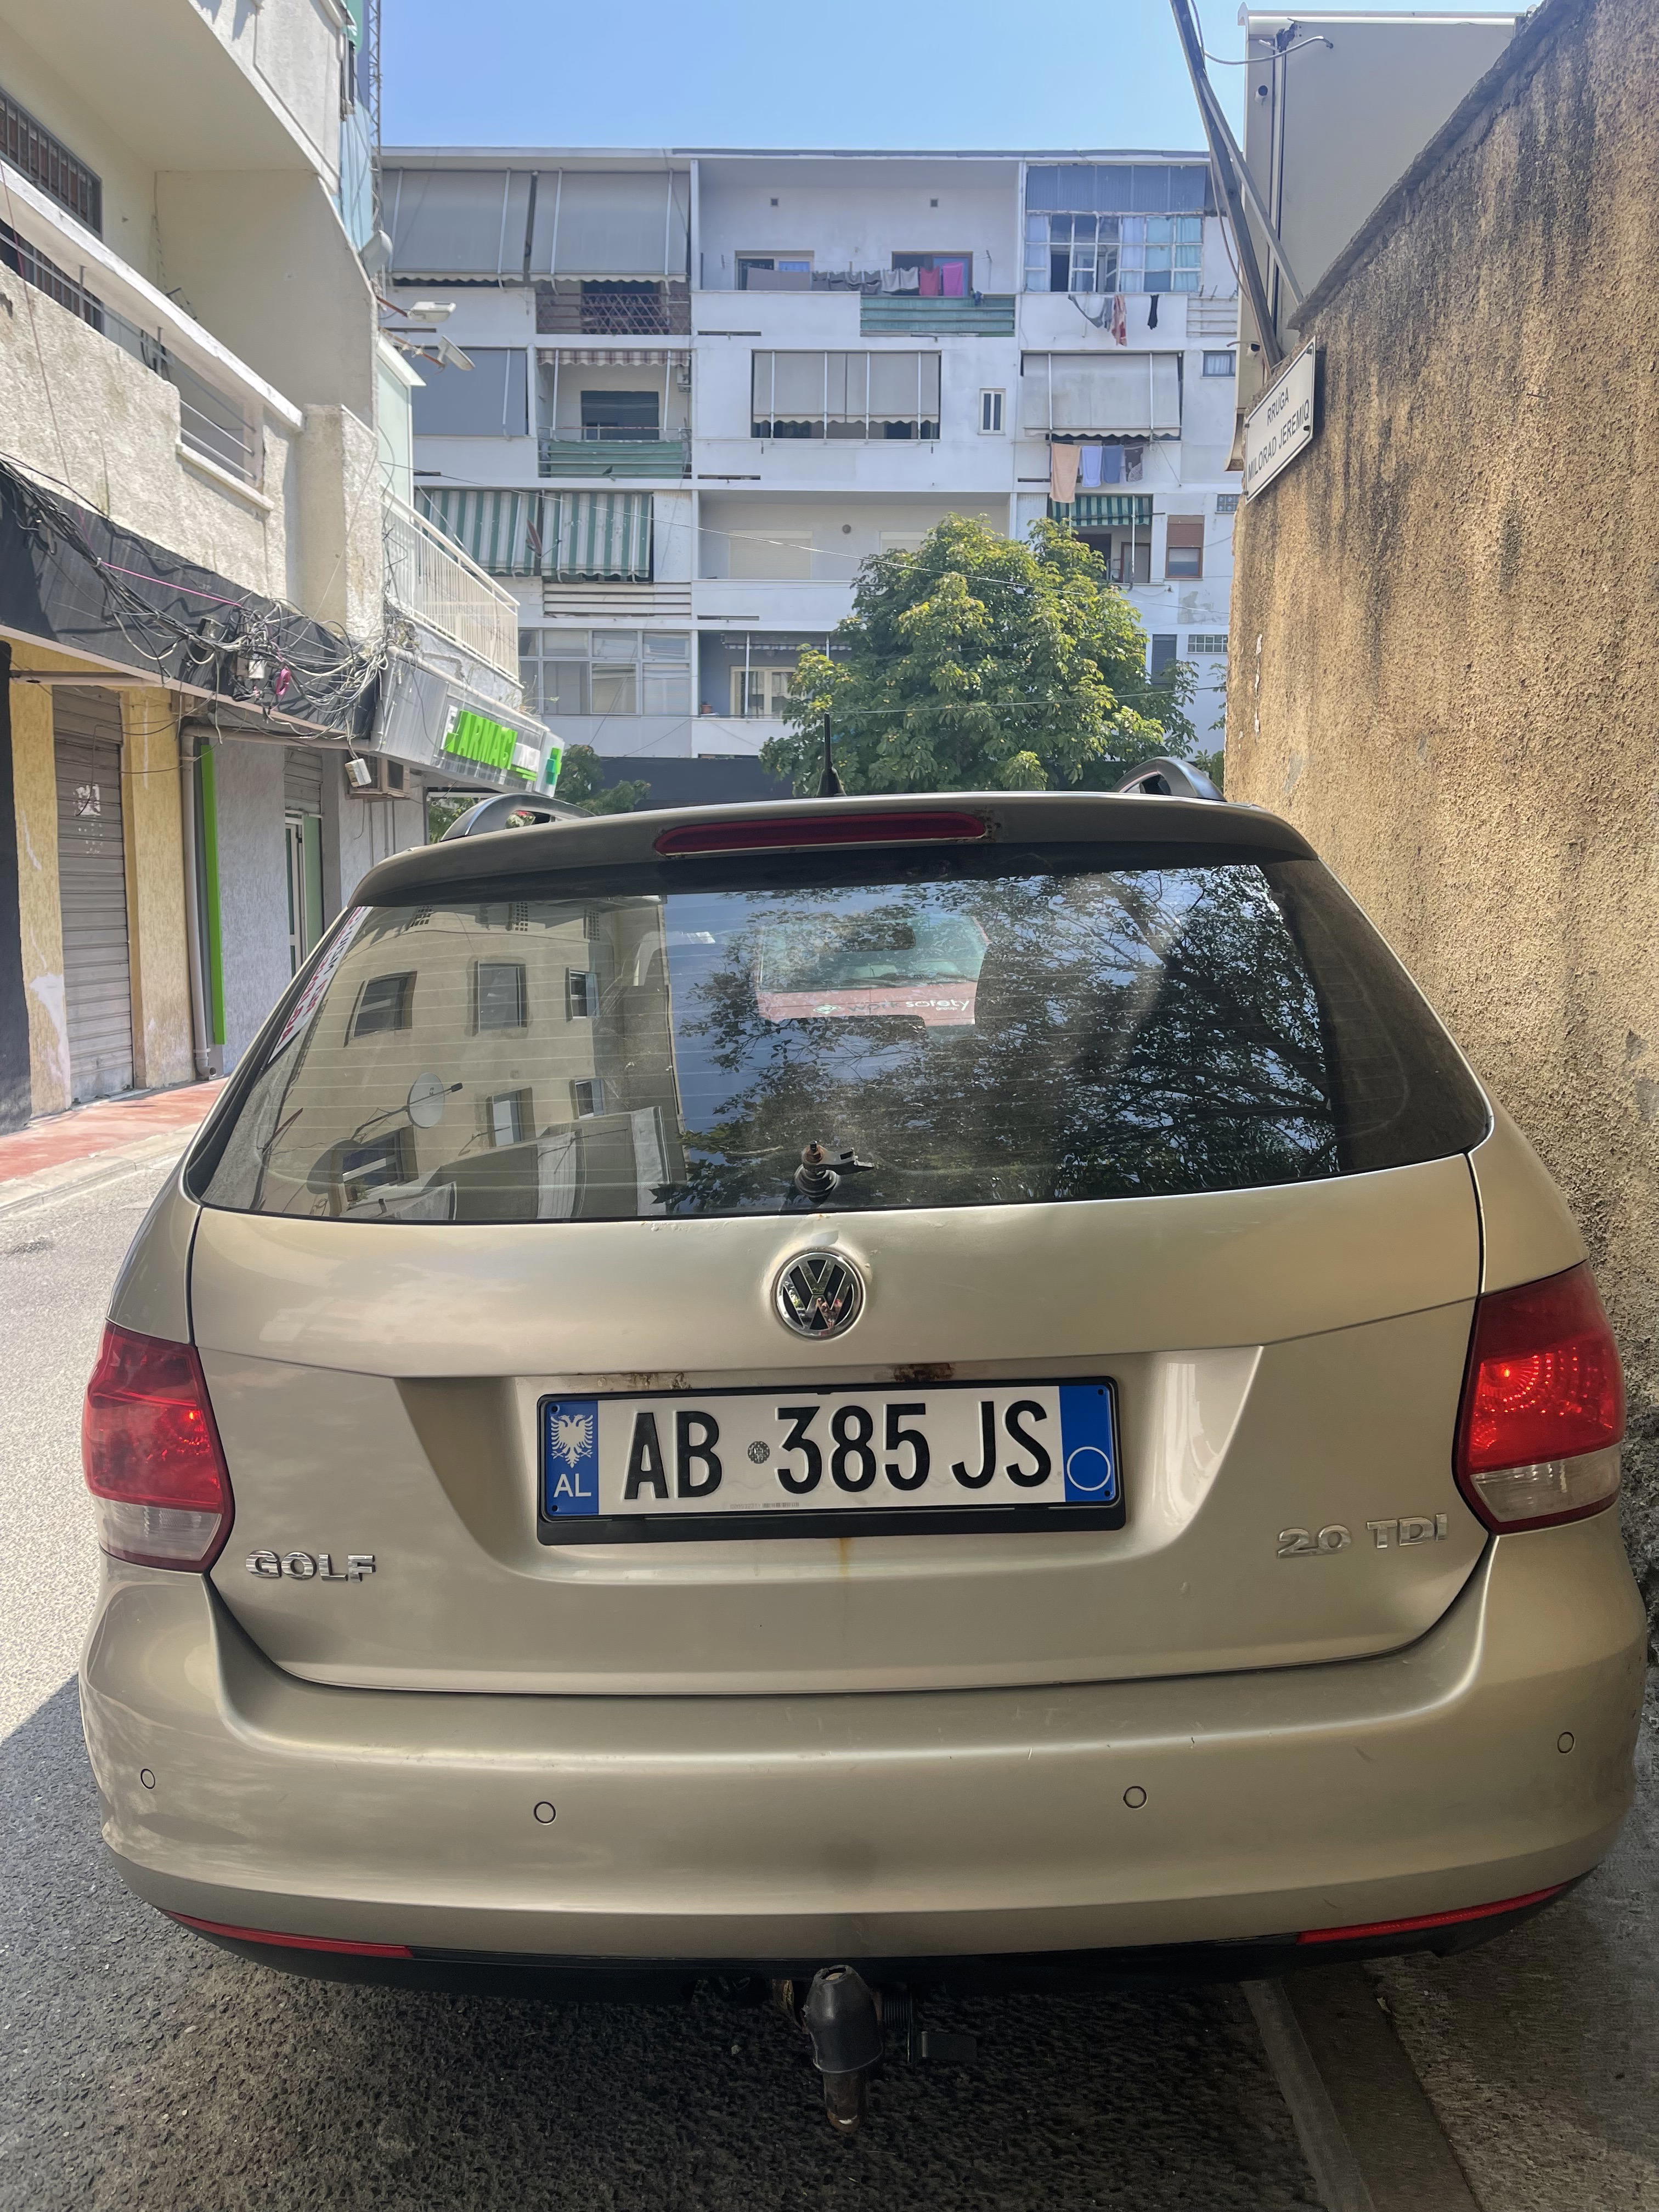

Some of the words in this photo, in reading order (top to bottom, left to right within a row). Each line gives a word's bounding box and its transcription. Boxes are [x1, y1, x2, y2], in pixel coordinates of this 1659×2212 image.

[1267, 387, 1289, 426] RRUGA
[1248, 436, 1277, 482] MILORAD
[1278, 399, 1310, 449] JEREMIQ
[623, 1410, 723, 1500] AB
[775, 1402, 931, 1495] 385
[951, 1399, 1052, 1491] JS
[553, 1473, 592, 1498] AL
[1366, 1513, 1448, 1549] TDI
[245, 1549, 376, 1582] GOLF
